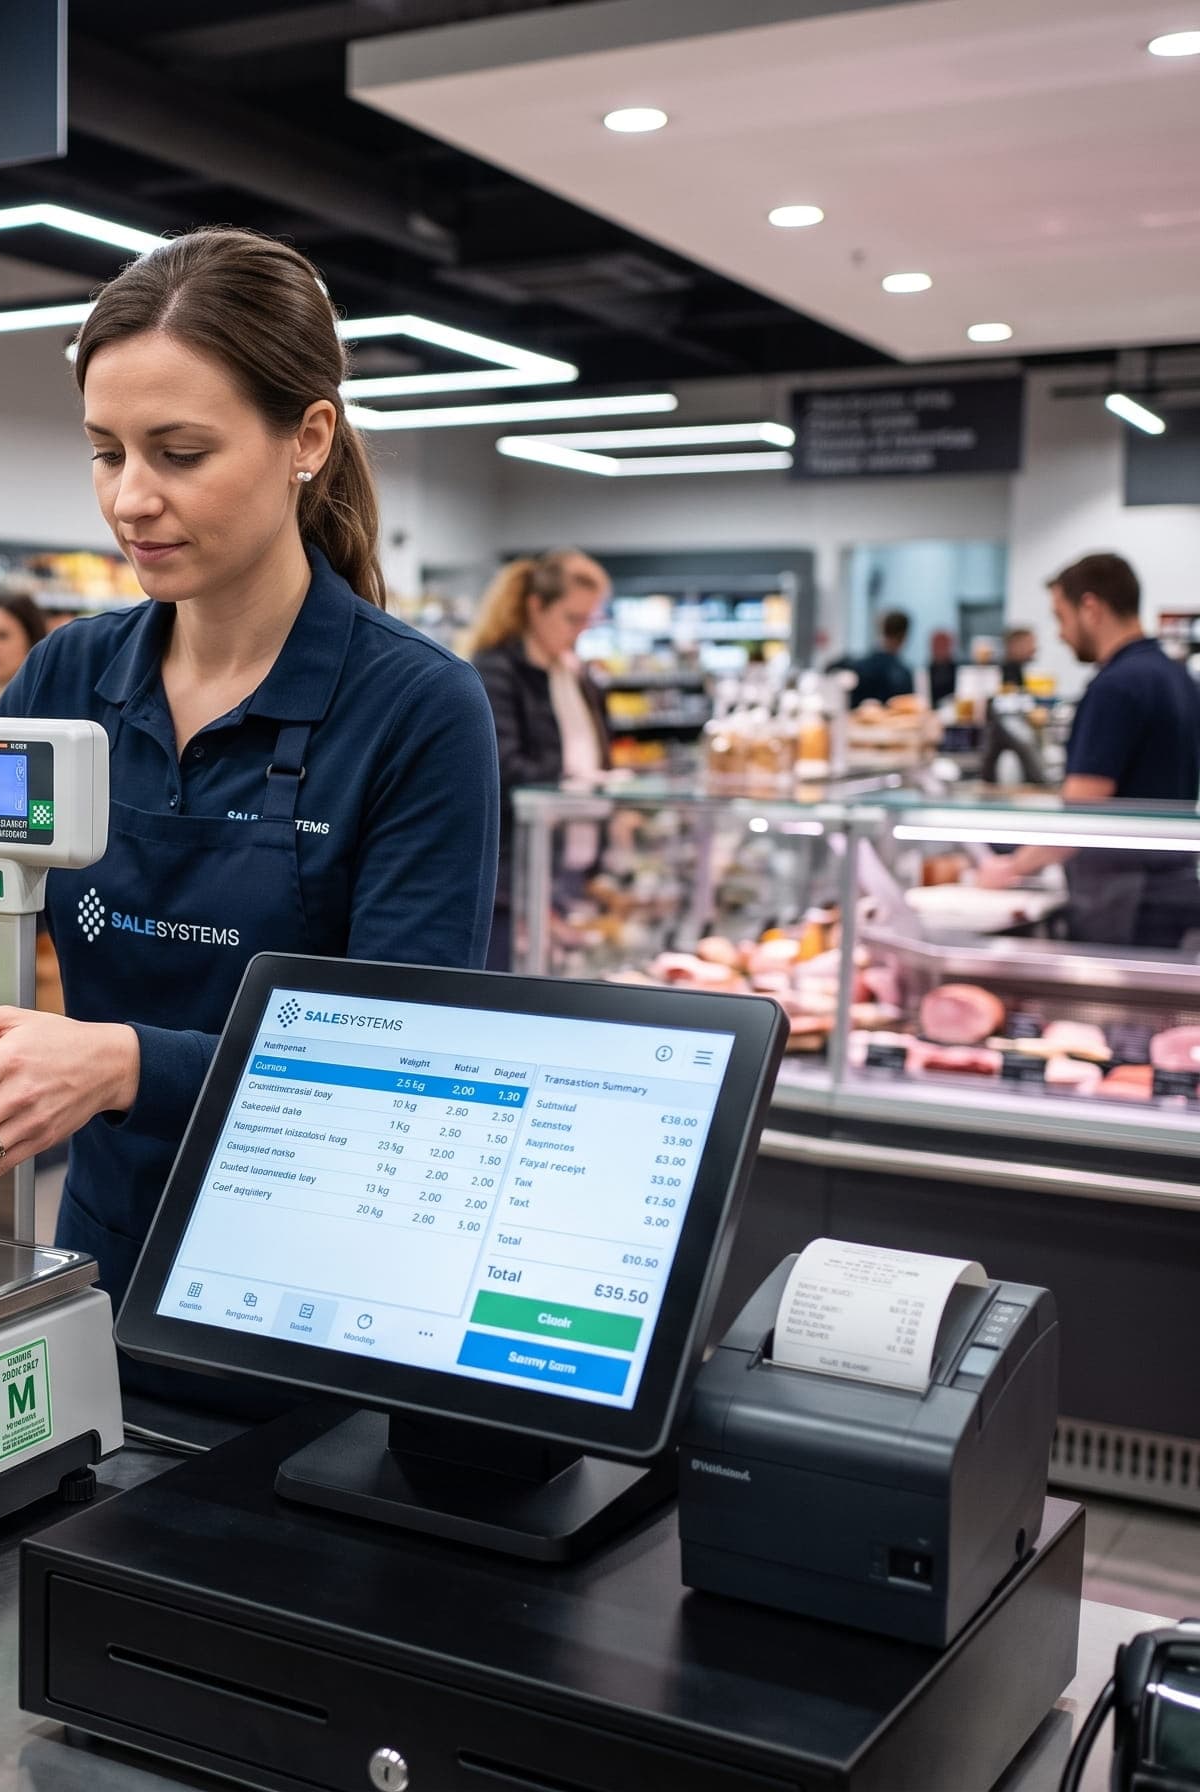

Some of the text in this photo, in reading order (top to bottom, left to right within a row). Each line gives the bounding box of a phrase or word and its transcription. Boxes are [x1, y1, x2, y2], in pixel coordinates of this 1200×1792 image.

[111, 911, 241, 946] SALESYSTEMS
[304, 1010, 403, 1031] SALESYSTEMS
[452, 1085, 475, 1097] 2.00
[602, 1081, 649, 1097] Summary
[393, 1099, 404, 1109] 10
[405, 1101, 418, 1113] kg
[384, 1163, 397, 1176] kg
[425, 1169, 449, 1181] 2.00
[471, 1176, 494, 1188] 2.00
[365, 1183, 376, 1193] 13
[377, 1185, 390, 1197] kg
[419, 1191, 442, 1203] 2.00
[464, 1198, 488, 1210] 2.00
[356, 1204, 370, 1214] 20
[497, 1233, 522, 1246] Total
[487, 1265, 523, 1283] Total
[8, 1374, 36, 1420] M
